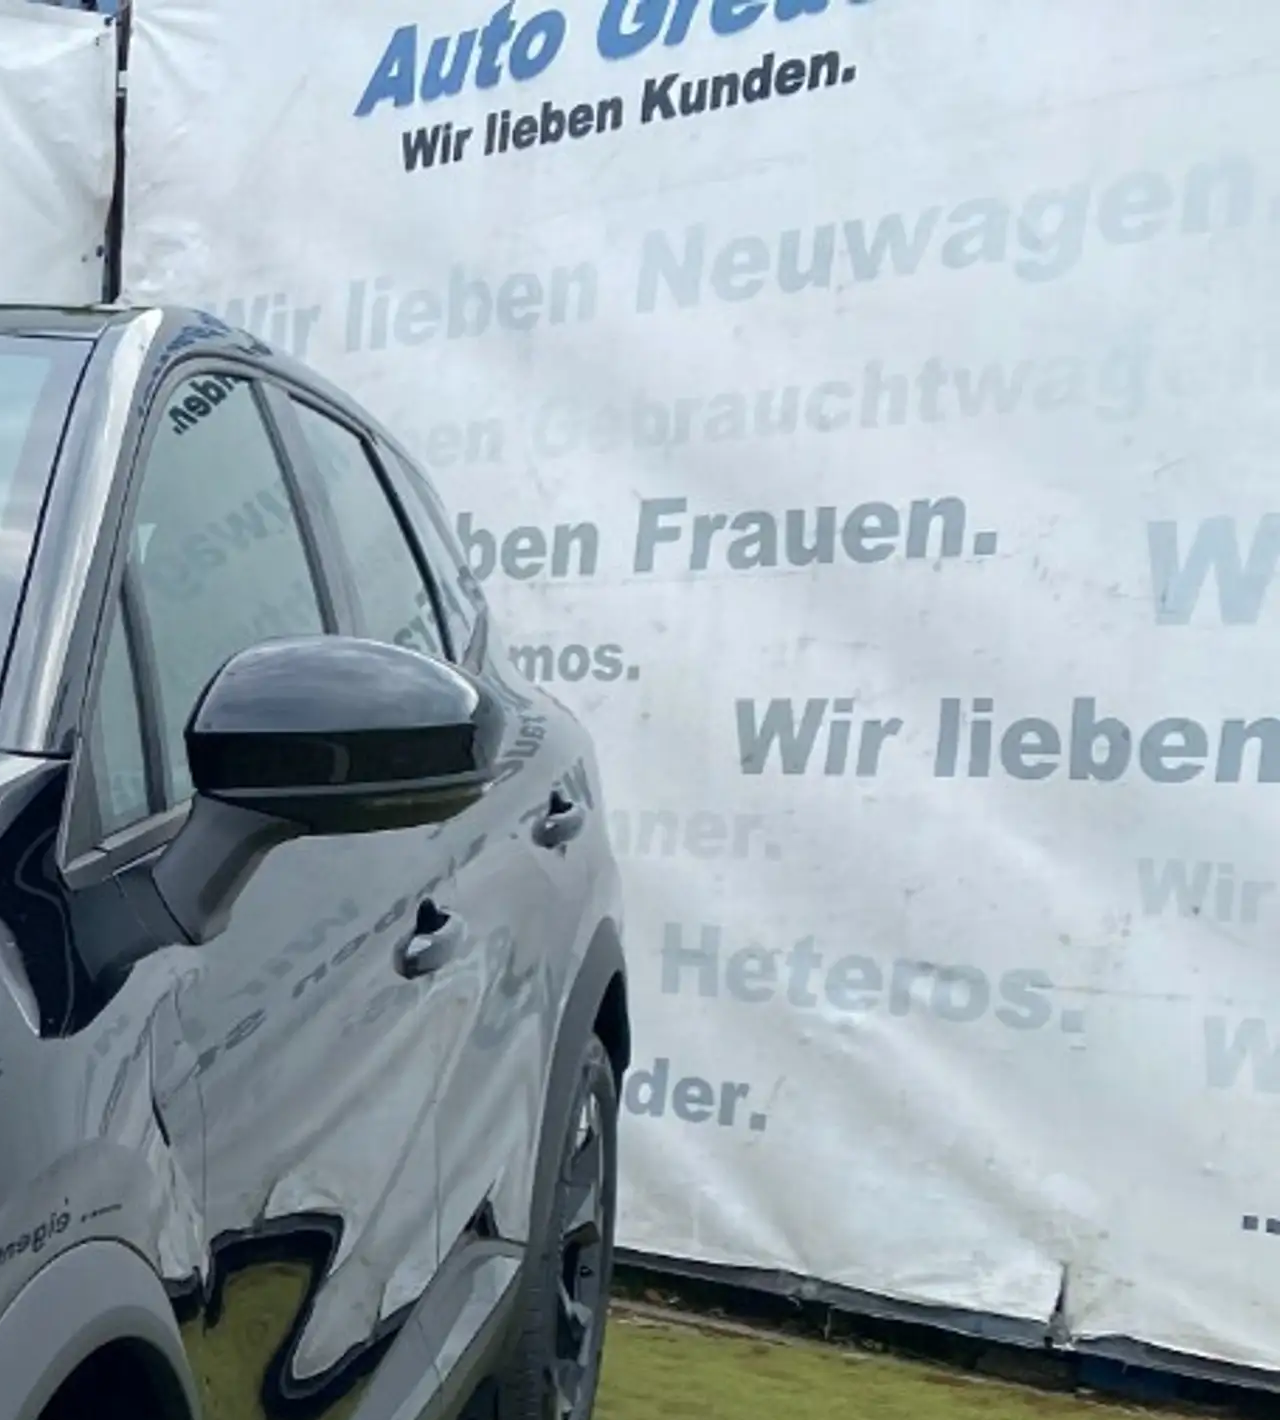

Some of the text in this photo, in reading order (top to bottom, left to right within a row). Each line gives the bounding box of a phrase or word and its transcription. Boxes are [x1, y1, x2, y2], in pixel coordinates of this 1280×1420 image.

[353, 0, 566, 117] Auto
[402, 49, 857, 172] Wir lieben Kunden.
[345, 258, 599, 354] lieben
[633, 494, 999, 574] Frauen.
[735, 696, 1280, 783] Wir lieben
[660, 921, 1086, 1034] Heteros.
